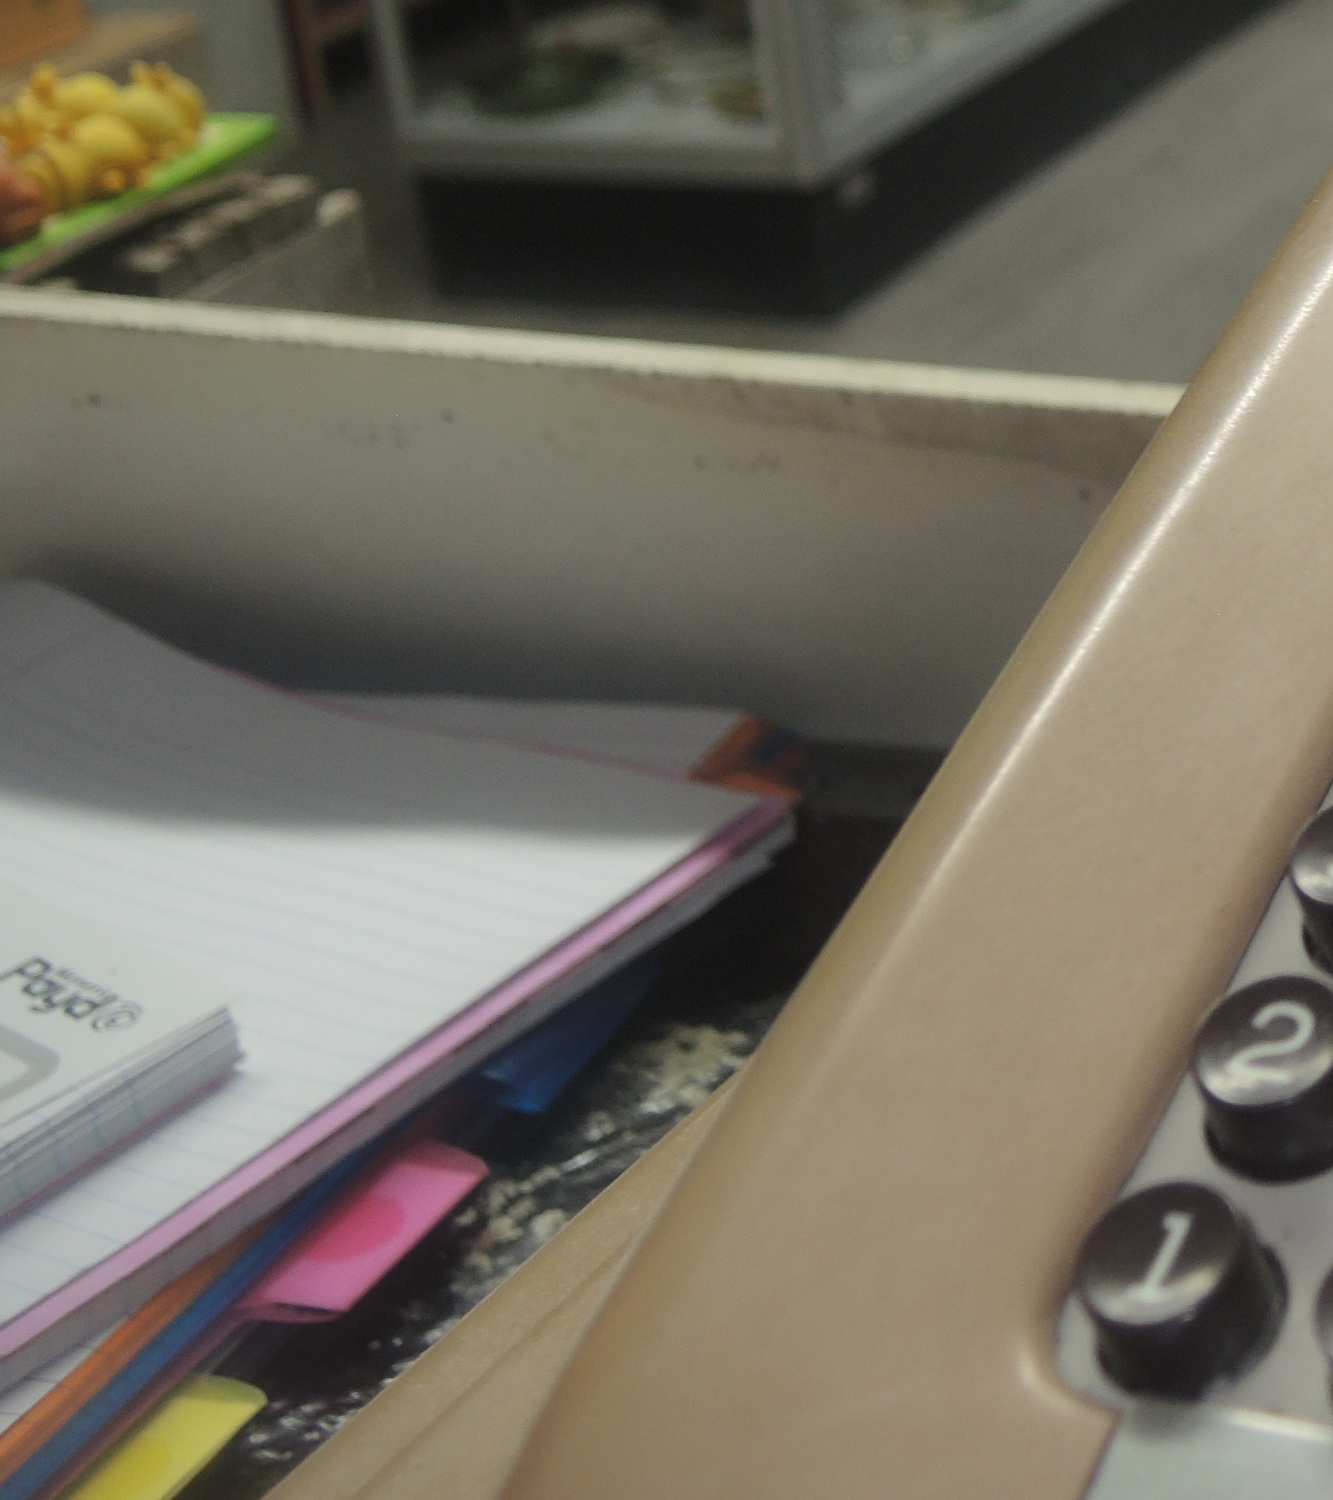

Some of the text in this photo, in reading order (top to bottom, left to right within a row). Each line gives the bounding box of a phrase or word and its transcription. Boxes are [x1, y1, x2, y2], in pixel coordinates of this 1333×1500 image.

[0, 955, 118, 1021] Payd
[1224, 1001, 1315, 1083] 2
[1136, 1212, 1194, 1302] 1
